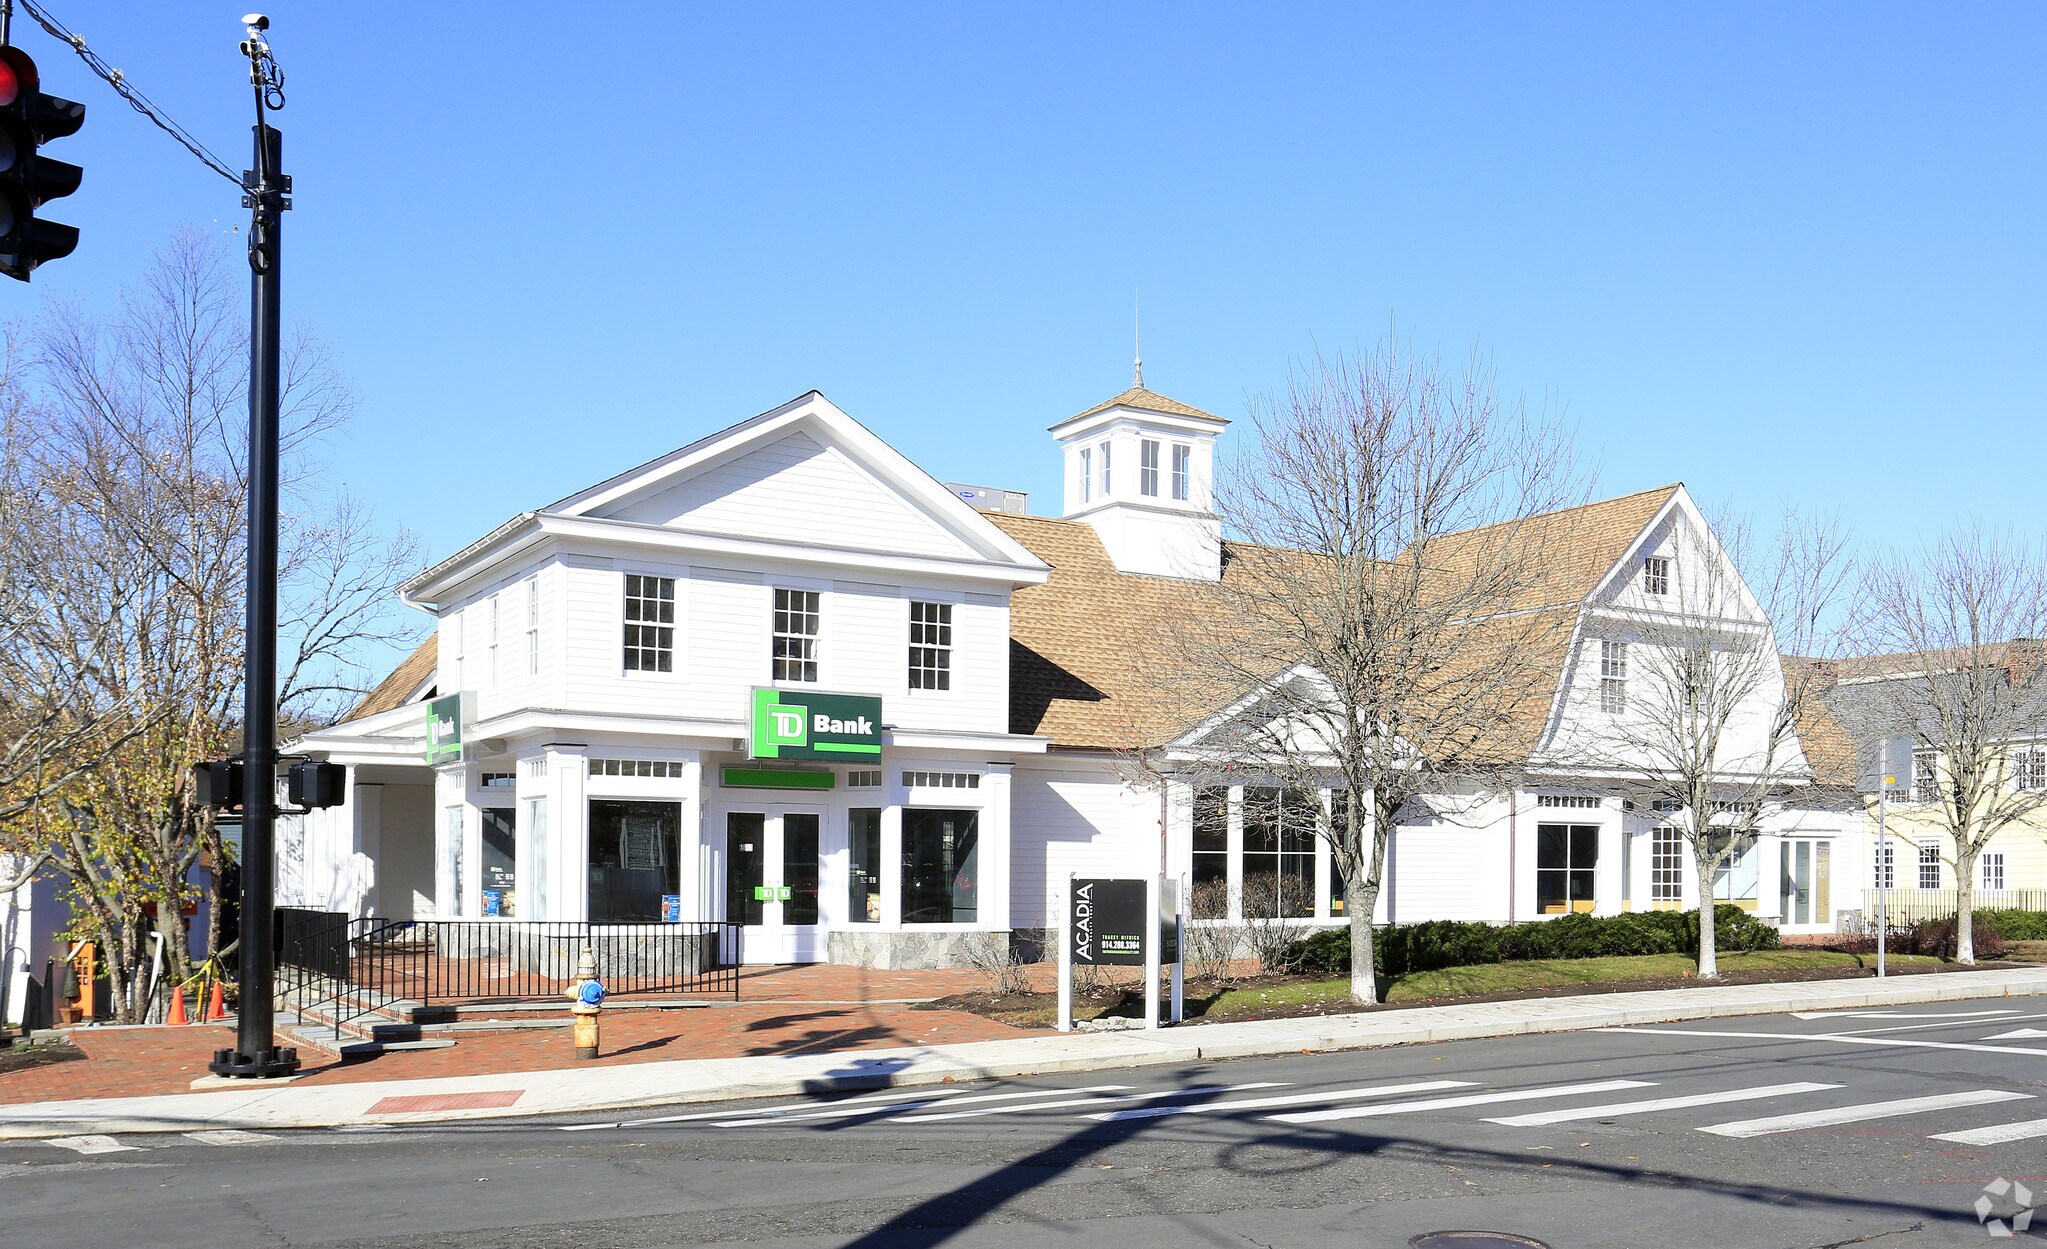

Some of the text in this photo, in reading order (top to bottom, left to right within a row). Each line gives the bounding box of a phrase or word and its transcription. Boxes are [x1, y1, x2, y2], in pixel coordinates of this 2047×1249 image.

[771, 711, 873, 738] TD Bank
[1076, 883, 1094, 961] ACADIA
